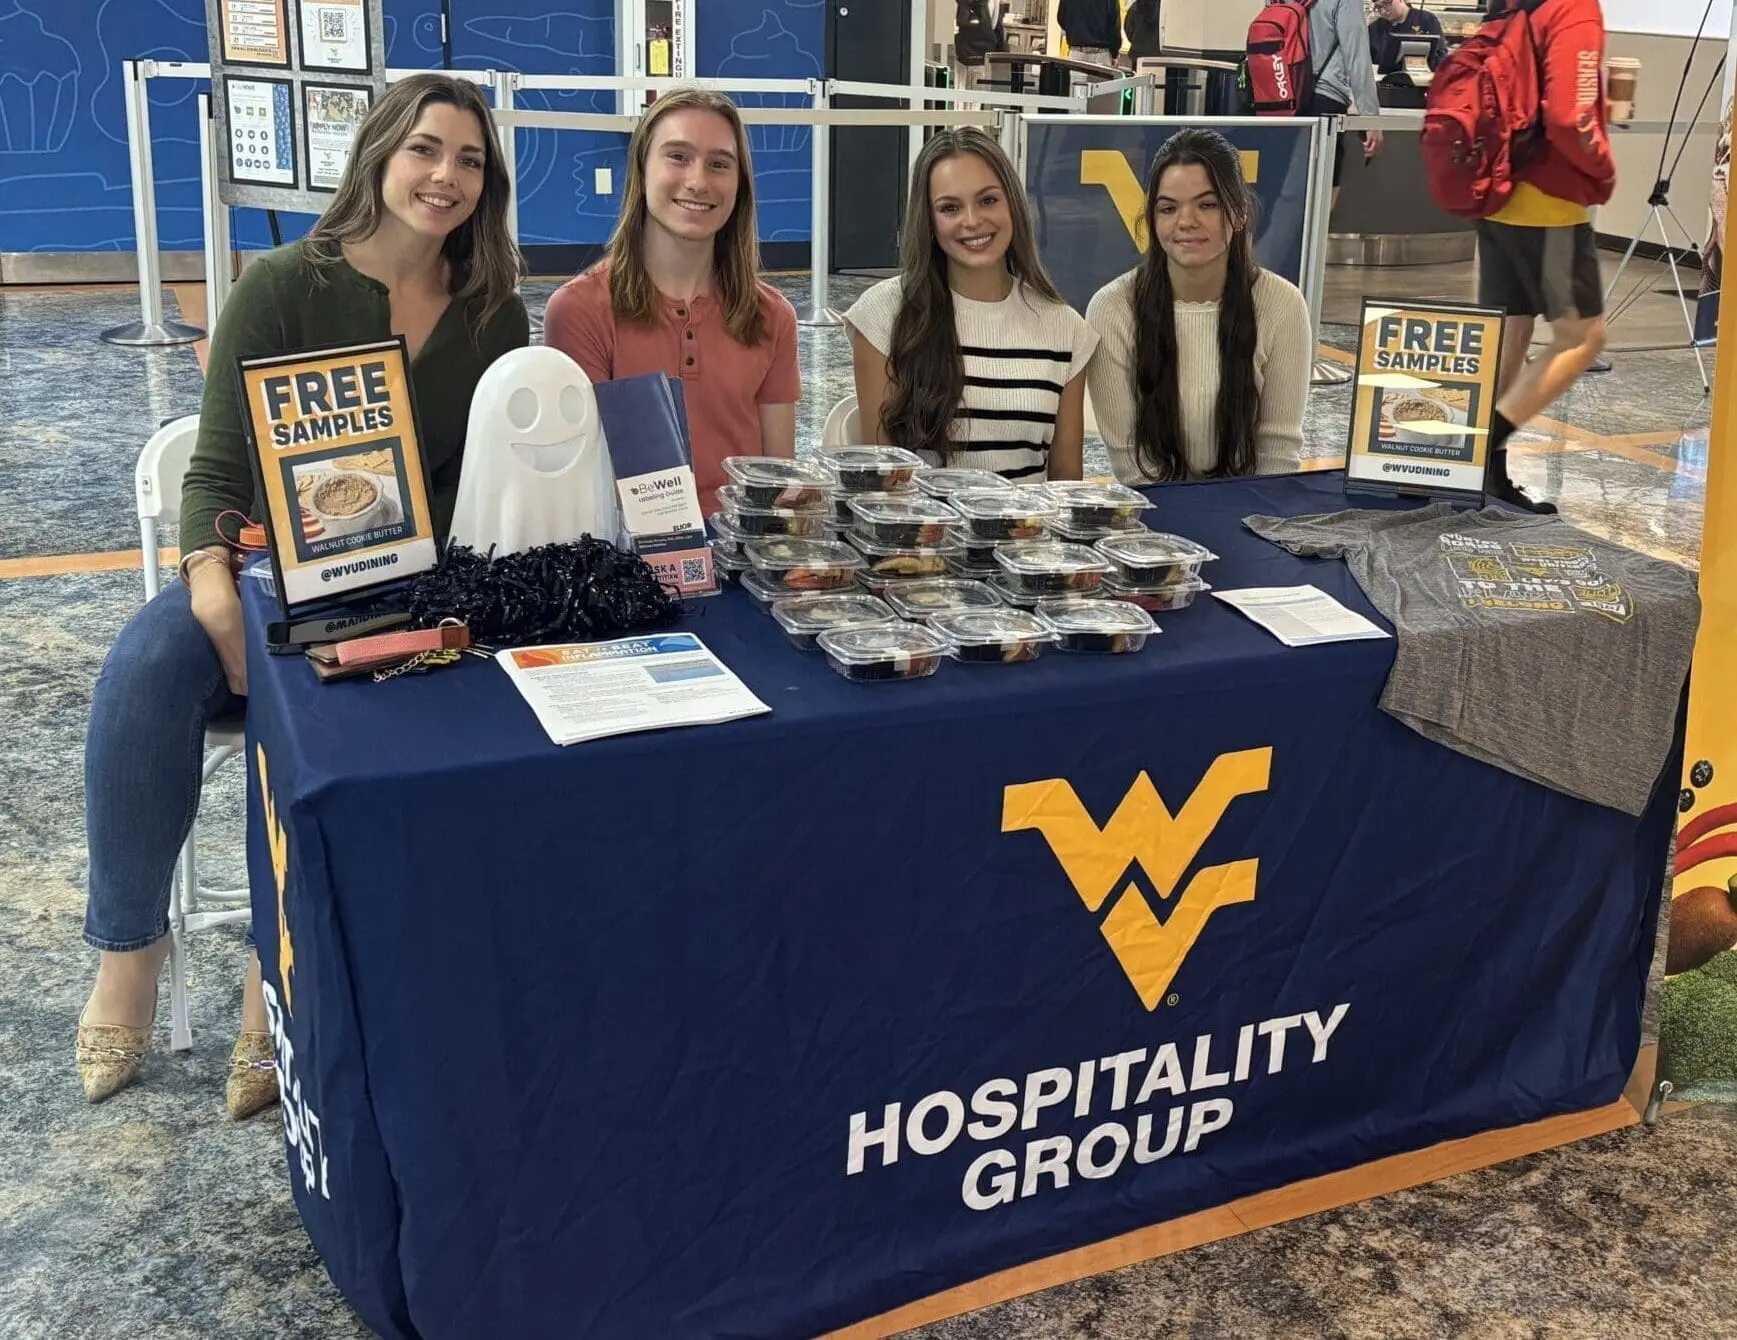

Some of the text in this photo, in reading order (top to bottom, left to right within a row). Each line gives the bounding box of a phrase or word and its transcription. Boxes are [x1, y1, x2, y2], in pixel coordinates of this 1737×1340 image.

[1272, 54, 1288, 99] OAKLEY
[1377, 316, 1485, 356] FREE
[1375, 350, 1480, 376] SAMPLES
[263, 361, 392, 421] FREE
[272, 405, 394, 447] SAMPLES
[1381, 443, 1409, 451] WALNUT
[1435, 448, 1461, 457] BUTTER
[639, 476, 682, 494] BeWell
[1382, 463, 1451, 477] @WVUDINING
[312, 526, 403, 553] WALNUT COOKIE BUTTER
[321, 553, 399, 581] @WVUDINING
[845, 1003, 1351, 1175] HOSPITALITY
[961, 1098, 1234, 1211] GROUP
